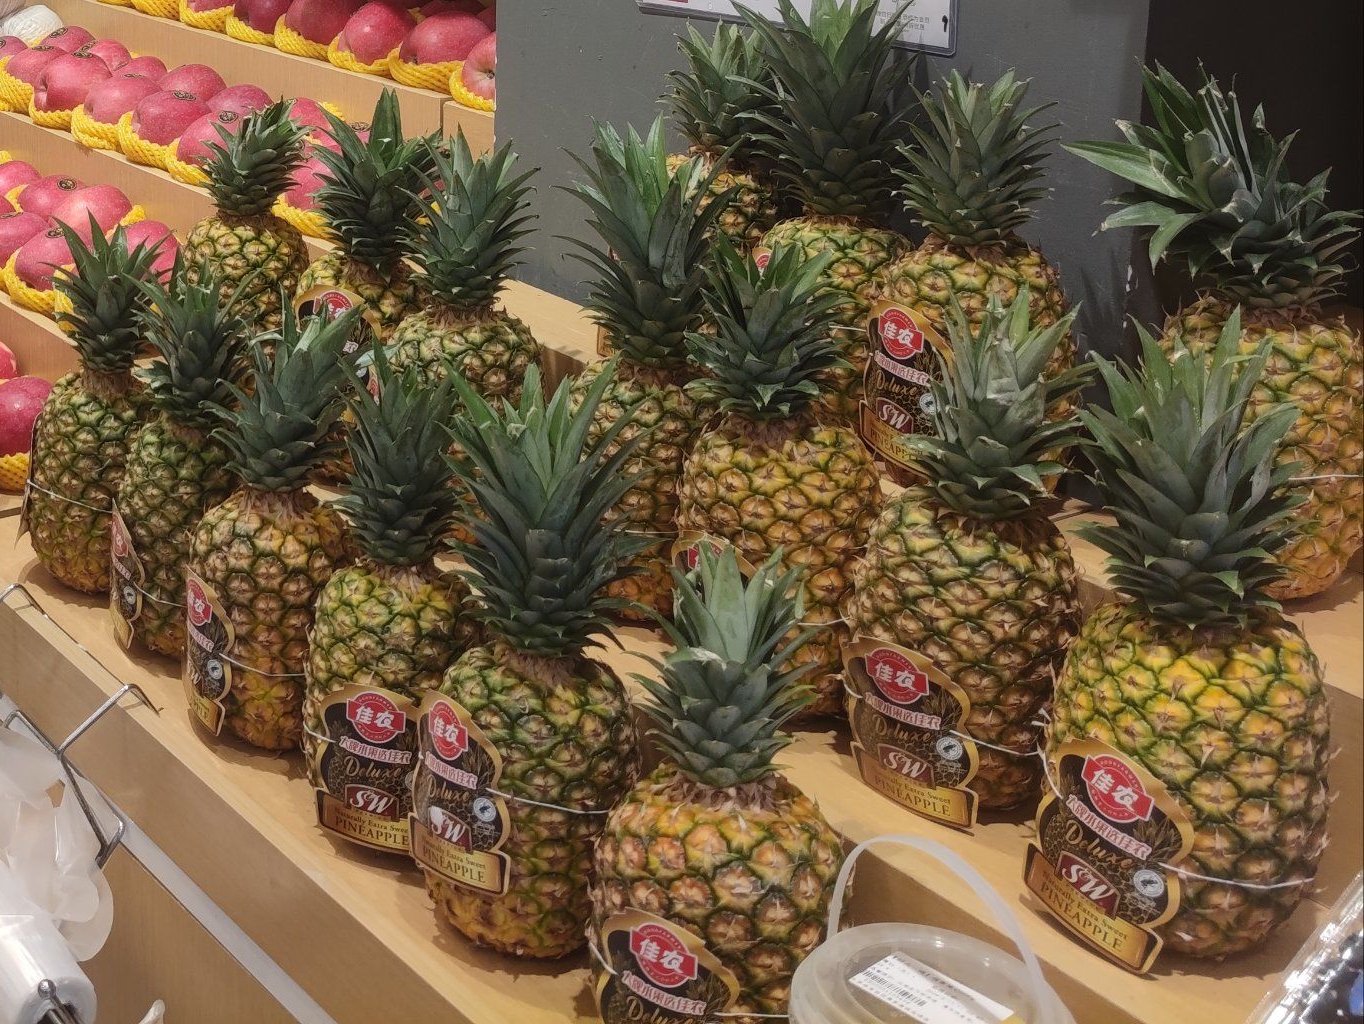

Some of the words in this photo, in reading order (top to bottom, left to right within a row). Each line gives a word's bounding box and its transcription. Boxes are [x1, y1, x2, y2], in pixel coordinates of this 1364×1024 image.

[884, 321, 914, 348] 佳农
[876, 369, 919, 396] Deluxe
[875, 662, 917, 692] 佳农
[355, 706, 396, 730] 佳农
[433, 717, 460, 746] 佳农
[872, 714, 933, 742] Deluxe
[343, 756, 402, 778] Deluxe
[428, 776, 470, 802] Deluxe
[875, 774, 951, 817] PINEAPPLE
[927, 791, 951, 805] Sweet
[1092, 769, 1139, 812] 佳农
[336, 816, 409, 846] PINEAPPLE
[389, 821, 409, 834] Swee
[1065, 819, 1134, 868] Deluxe
[423, 846, 486, 884] PINEAPPLE
[465, 857, 486, 869] Sweet
[1040, 883, 1125, 950] PINEAPPLE
[640, 938, 684, 974] 佳农
